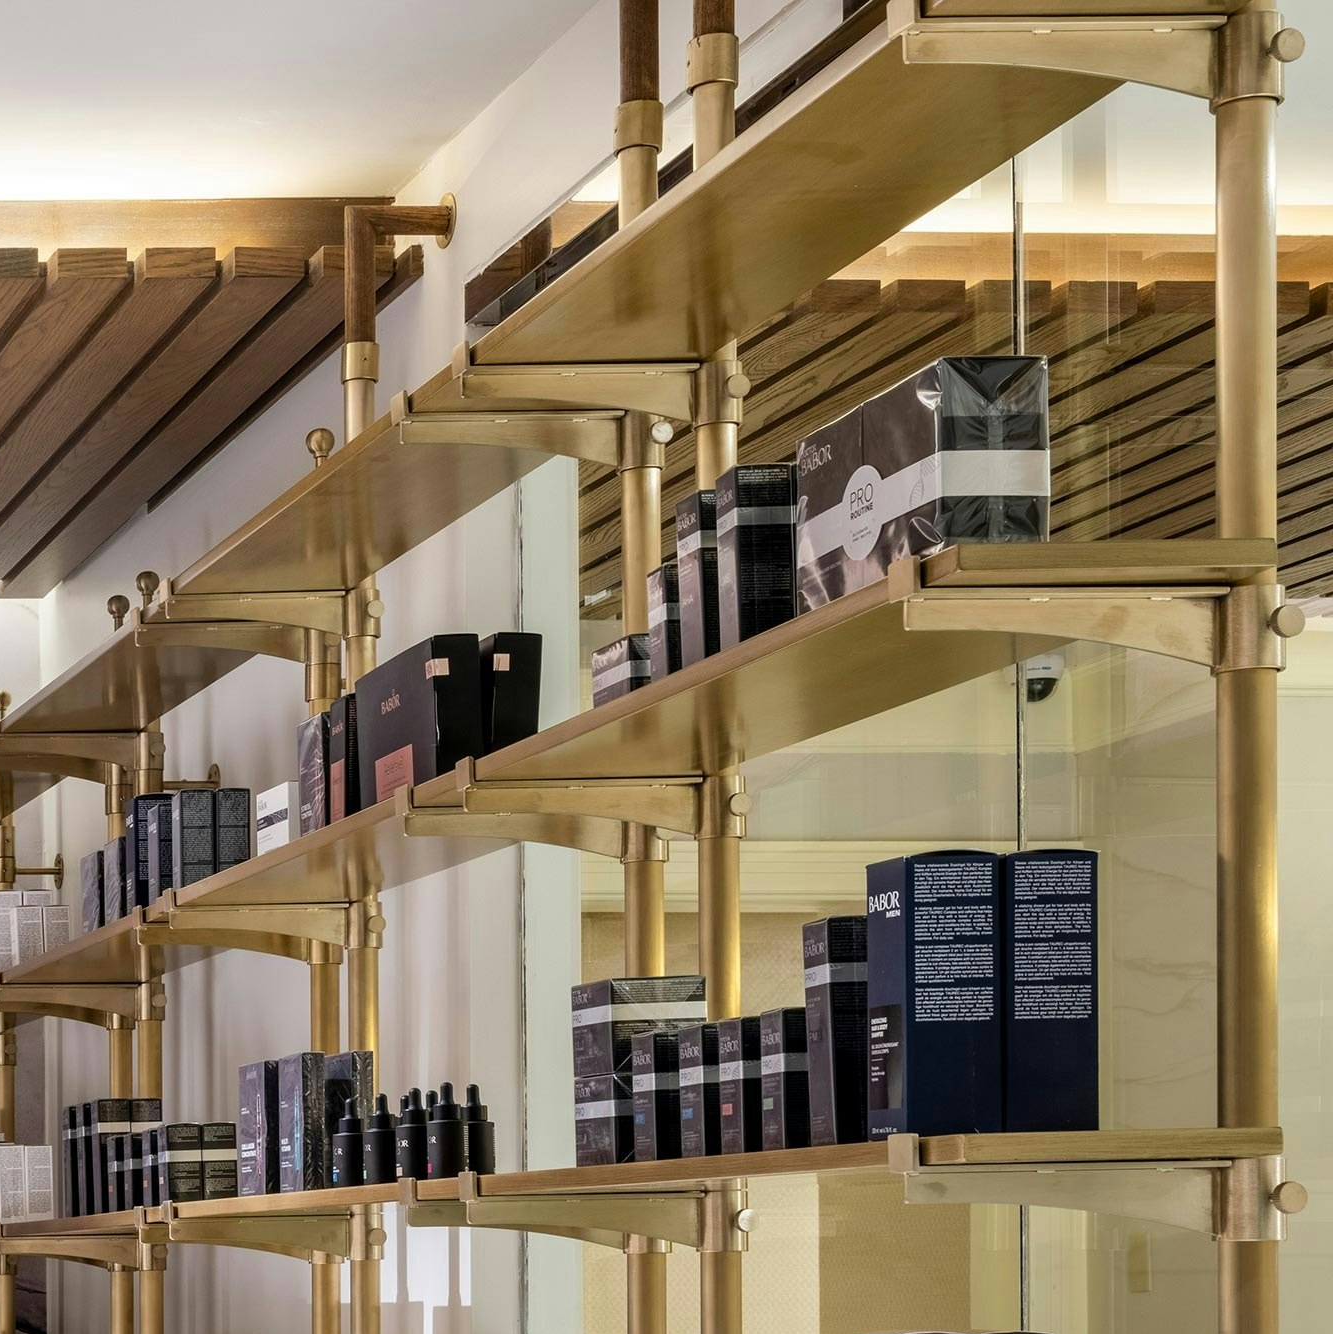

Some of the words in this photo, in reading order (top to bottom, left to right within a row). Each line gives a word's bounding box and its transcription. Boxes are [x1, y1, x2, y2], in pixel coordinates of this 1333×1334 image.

[801, 444, 832, 477] BABOR
[850, 483, 874, 511] PRO
[850, 502, 874, 520] ROUTINE
[677, 513, 697, 532] BABOR
[381, 693, 401, 716] BABOR
[869, 891, 900, 914] BABOR
[886, 909, 901, 918] MEN
[804, 942, 825, 958] BABOR
[805, 971, 816, 982] PRO
[573, 1014, 581, 1024] PRO
[761, 1032, 781, 1046] BABOR
[680, 1046, 700, 1060] BABOR
[720, 1039, 739, 1054] BABOR
[633, 1054, 651, 1066] BABOR
[762, 1060, 773, 1070] PRO
[681, 1070, 691, 1081] PRO
[721, 1066, 731, 1077] PRO
[634, 1078, 644, 1088] PRO
[575, 1107, 584, 1118] PRO
